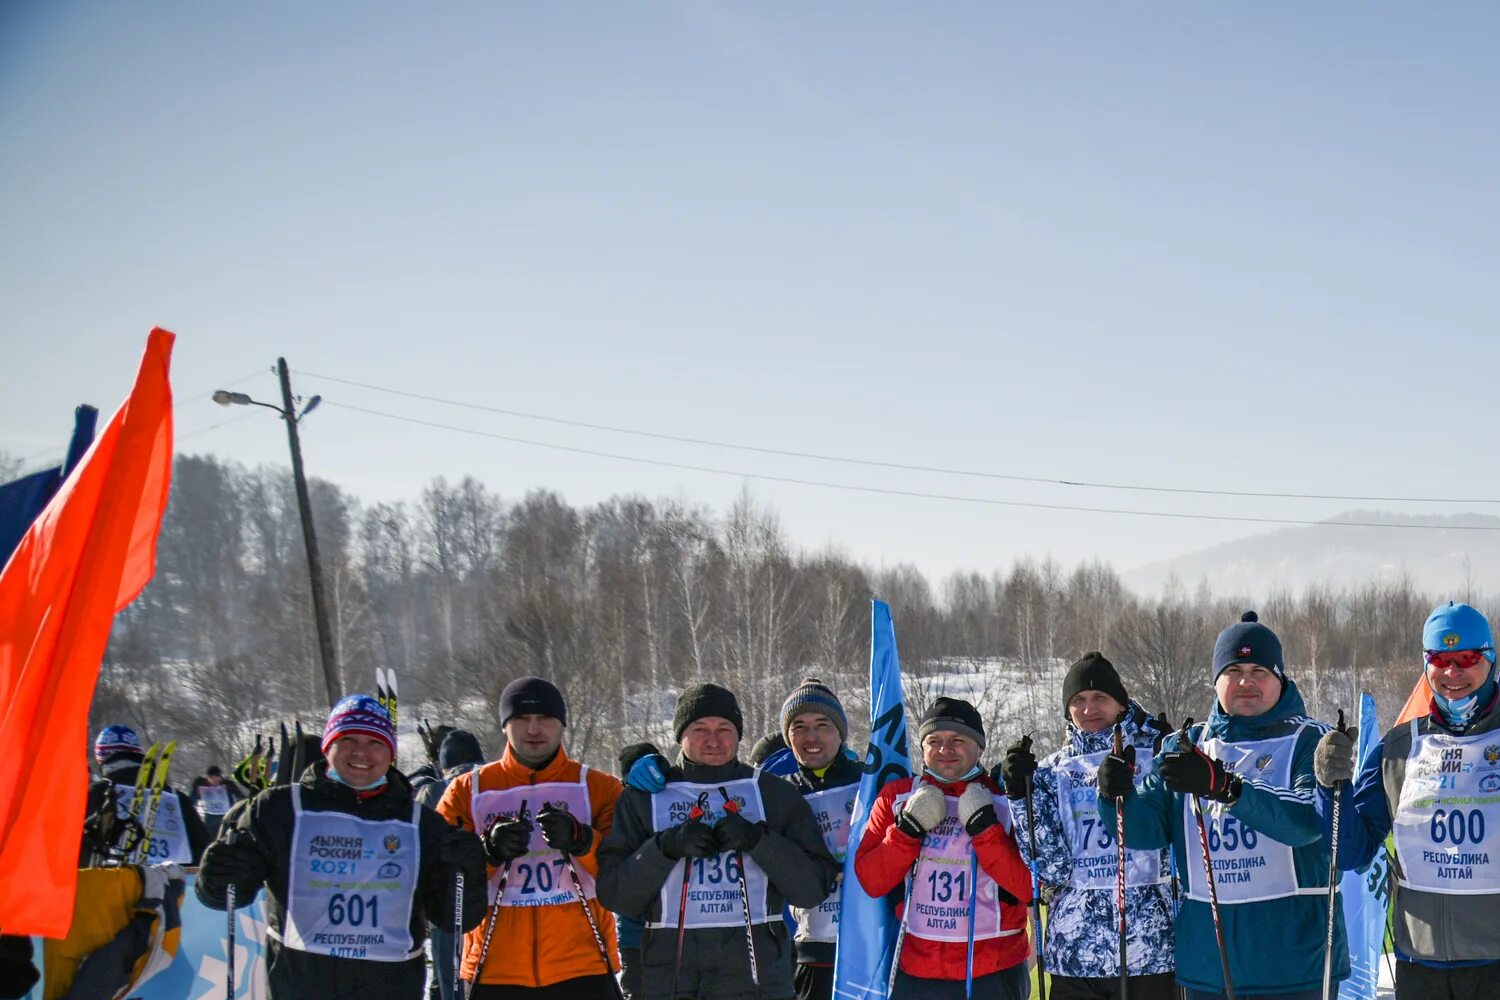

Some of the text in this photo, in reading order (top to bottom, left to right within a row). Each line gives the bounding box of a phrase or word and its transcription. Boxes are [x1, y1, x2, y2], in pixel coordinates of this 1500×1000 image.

[1082, 818, 1117, 850] 73
[1208, 818, 1258, 852] 656
[1332, 800, 1341, 851] NORDWAY
[1430, 808, 1485, 846] 600
[309, 846, 362, 860] РОССИИ
[310, 835, 363, 848] ЛЫЖНЯ
[310, 859, 357, 875] 2021
[693, 853, 741, 885] 136
[1116, 813, 1125, 909] MADSHUS
[1423, 850, 1490, 865] РЕСПУБЛИКА
[517, 858, 566, 895] 207
[1218, 870, 1251, 884] АЛТАЙ
[1437, 866, 1473, 880] АЛТАЙ
[928, 870, 966, 902] 131
[328, 893, 378, 928] 601
[573, 881, 606, 954] MADSHUS
[700, 901, 734, 914] АЛТАЙ
[927, 919, 957, 930] АЛТАЙ
[313, 933, 385, 945] РЕСПУБЛИКА
[330, 946, 367, 958] АЛТАЙ
